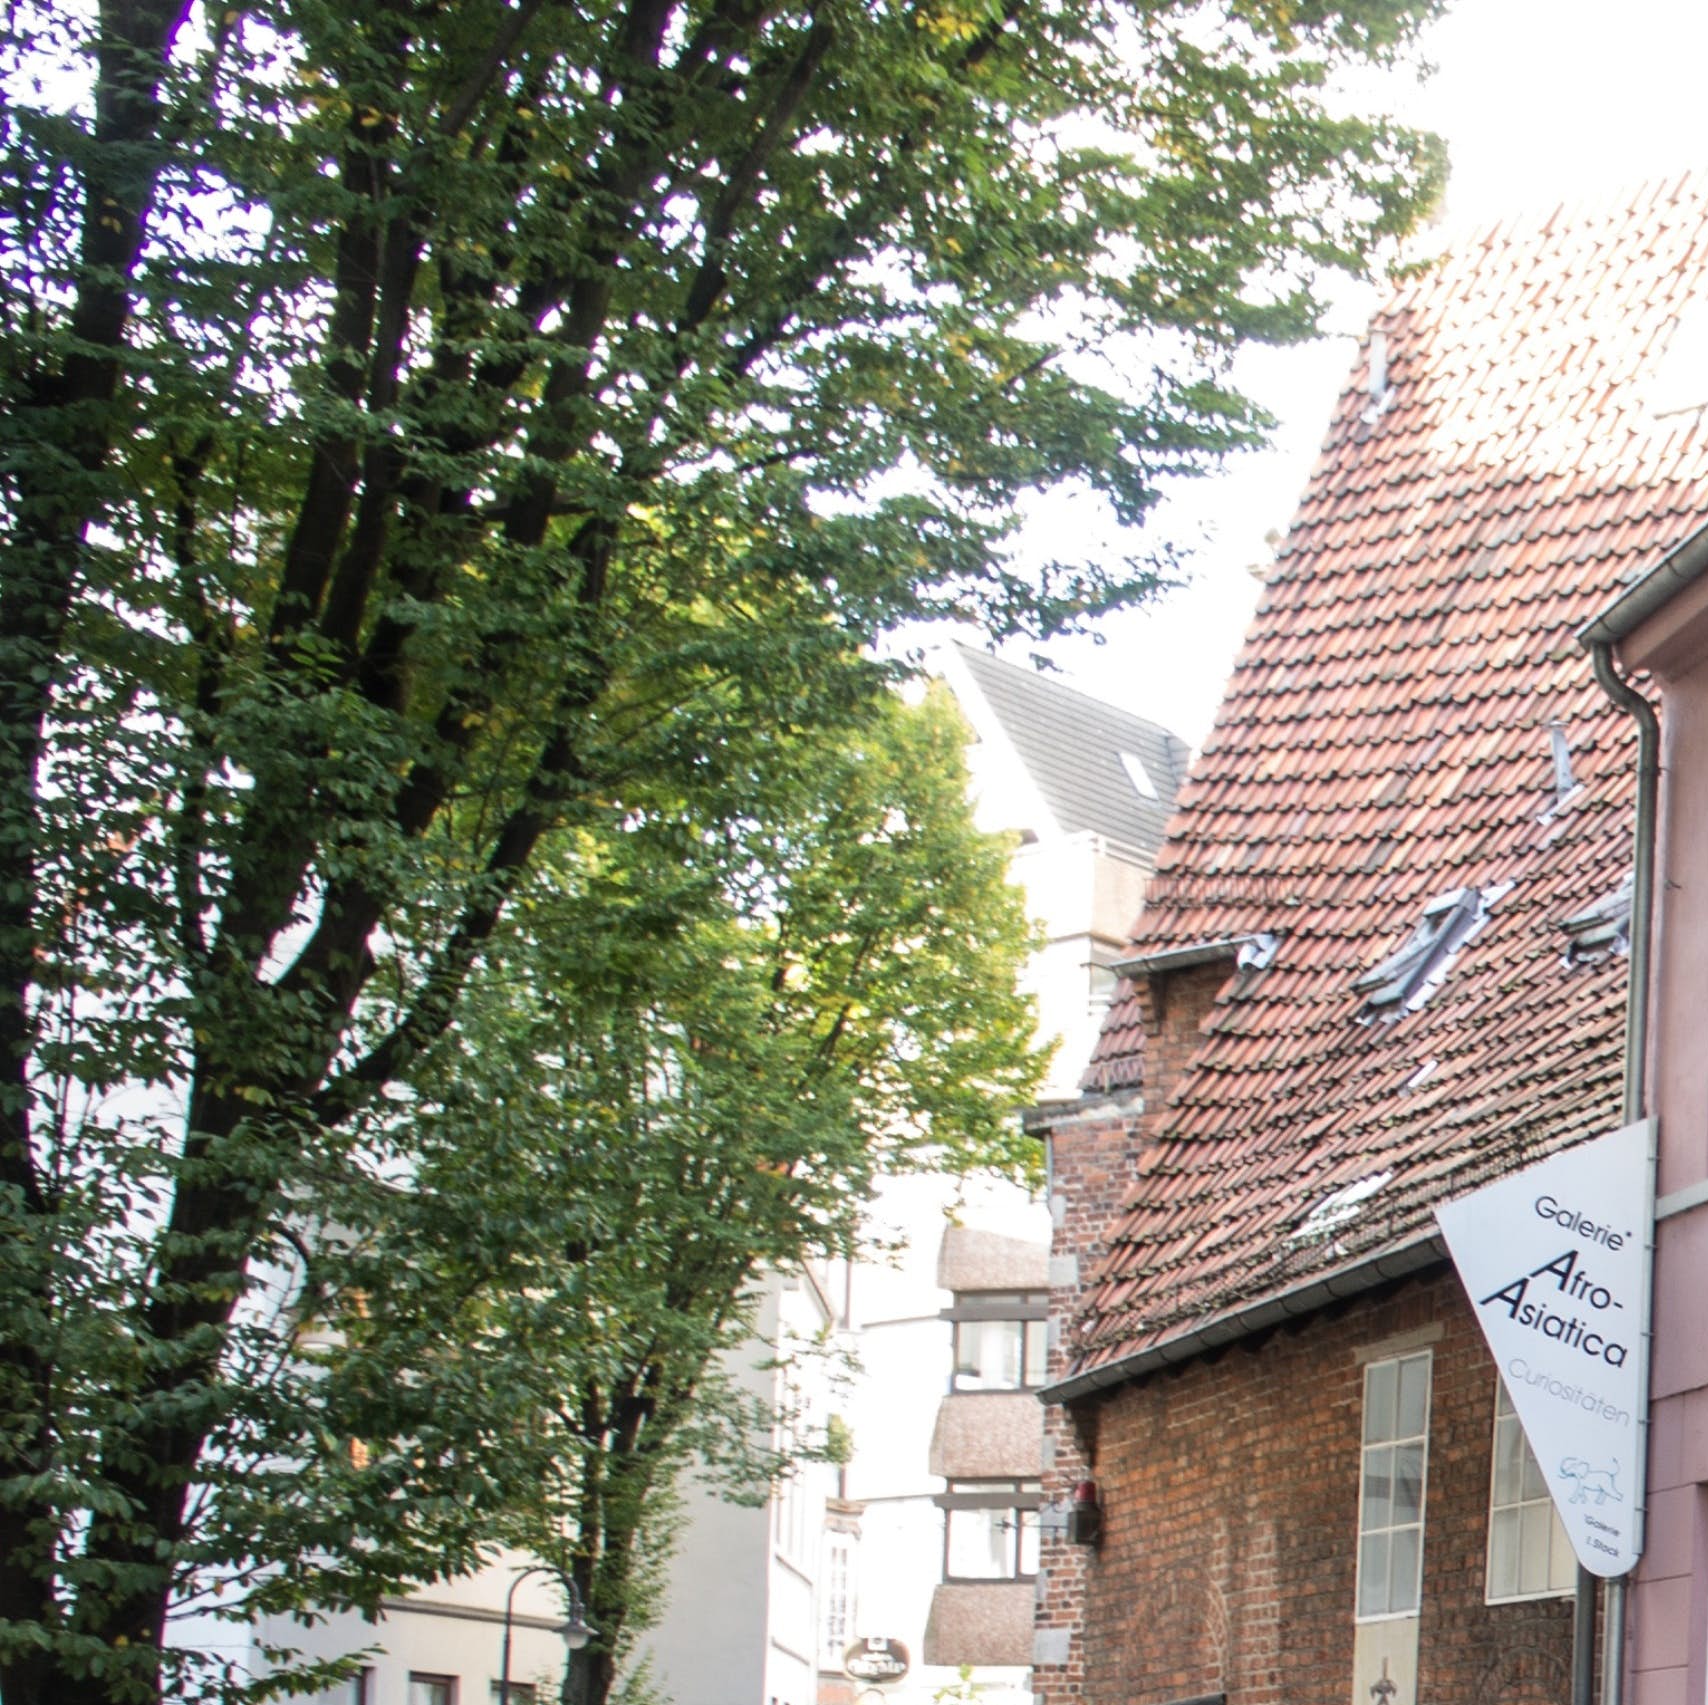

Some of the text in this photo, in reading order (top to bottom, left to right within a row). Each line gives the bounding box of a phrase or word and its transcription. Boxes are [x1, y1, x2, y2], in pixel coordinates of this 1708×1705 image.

[1529, 1249, 1624, 1310] Afro-
[1479, 1277, 1629, 1368] Asiatica
[1507, 1357, 1631, 1428] Curiositäten
